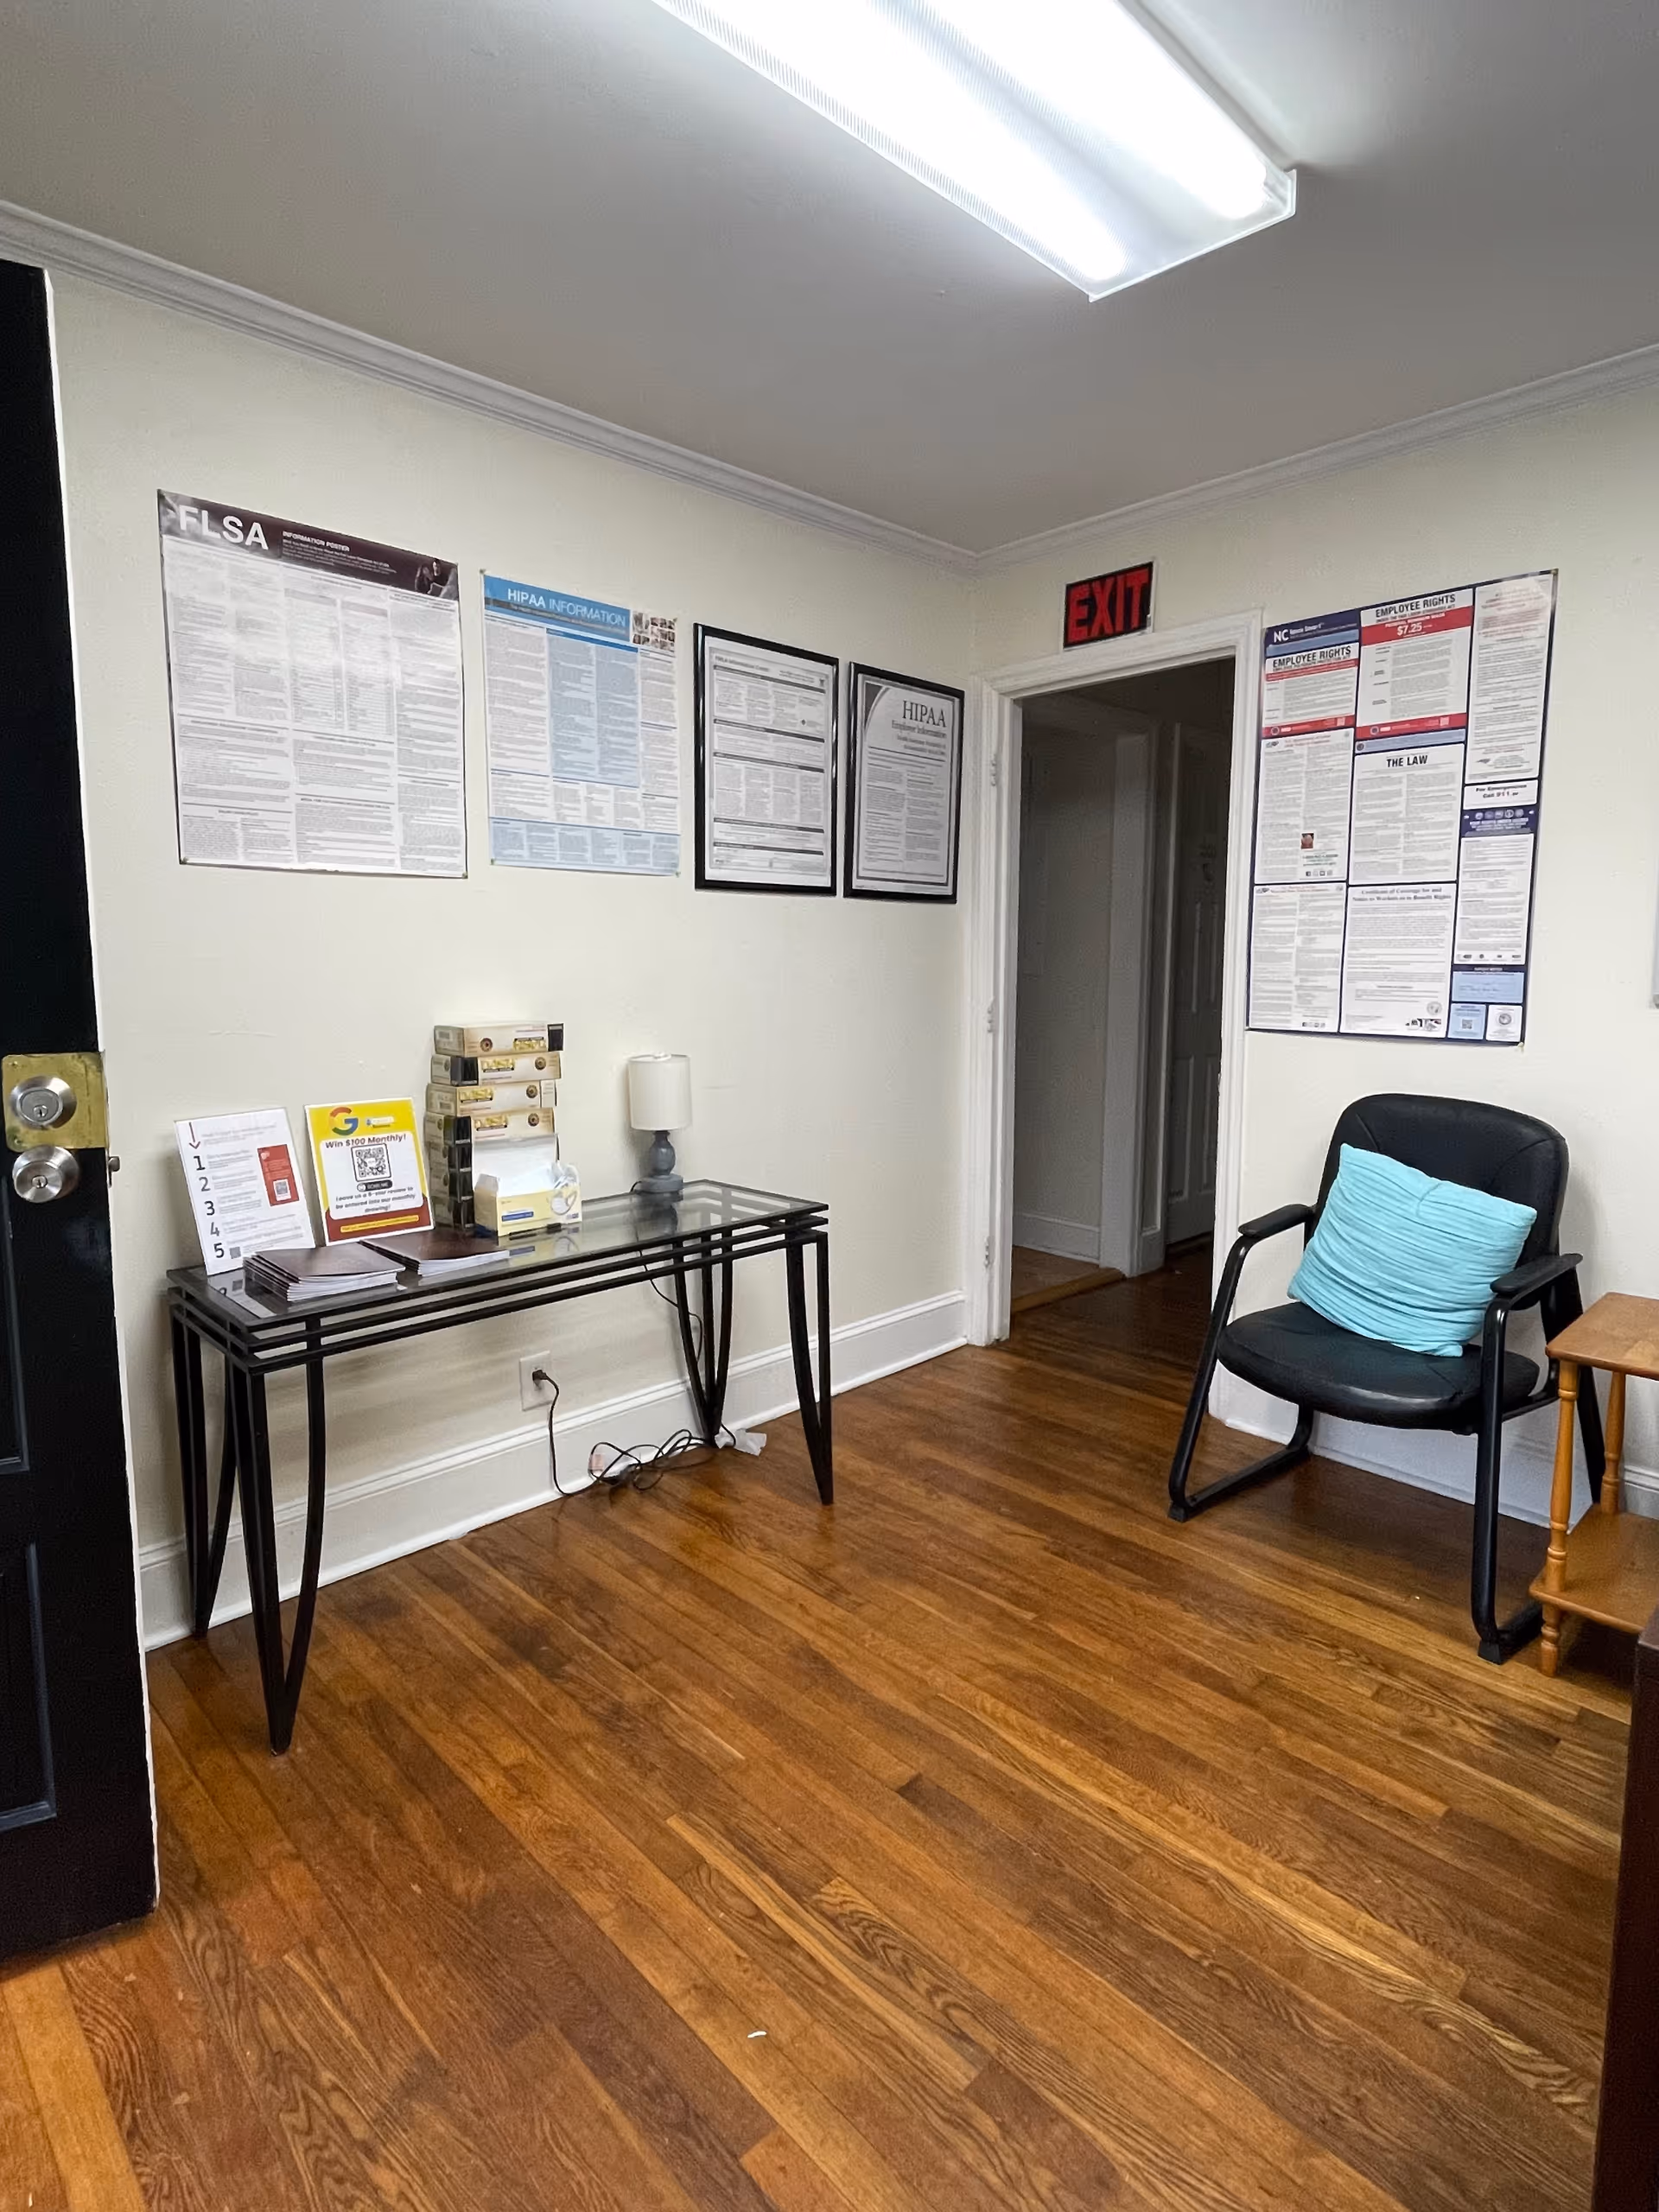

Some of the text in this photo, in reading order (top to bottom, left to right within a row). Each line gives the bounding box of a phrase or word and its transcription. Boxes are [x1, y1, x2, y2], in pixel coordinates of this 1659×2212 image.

[178, 504, 270, 550] FLSA
[282, 531, 350, 553] INFORMATION POSTER
[507, 588, 546, 608] HIPAA
[549, 598, 626, 627] INFORMATION
[1067, 567, 1149, 644] EXIT
[1375, 594, 1456, 618] EMPLOYEE RIGHTS
[1274, 629, 1289, 643] NC
[1396, 622, 1423, 636] $7.25
[1273, 652, 1317, 668] EMPLOYEE
[1319, 645, 1351, 659] RIGHTS
[902, 700, 946, 728] HIPAA
[1387, 754, 1428, 768] THE LAW
[325, 1133, 407, 1149] Win $100 Monthly!
[194, 1155, 206, 1171] 1
[199, 1176, 211, 1192] 2
[204, 1200, 215, 1216] 3
[210, 1222, 220, 1236] 4
[213, 1243, 225, 1258] 5
